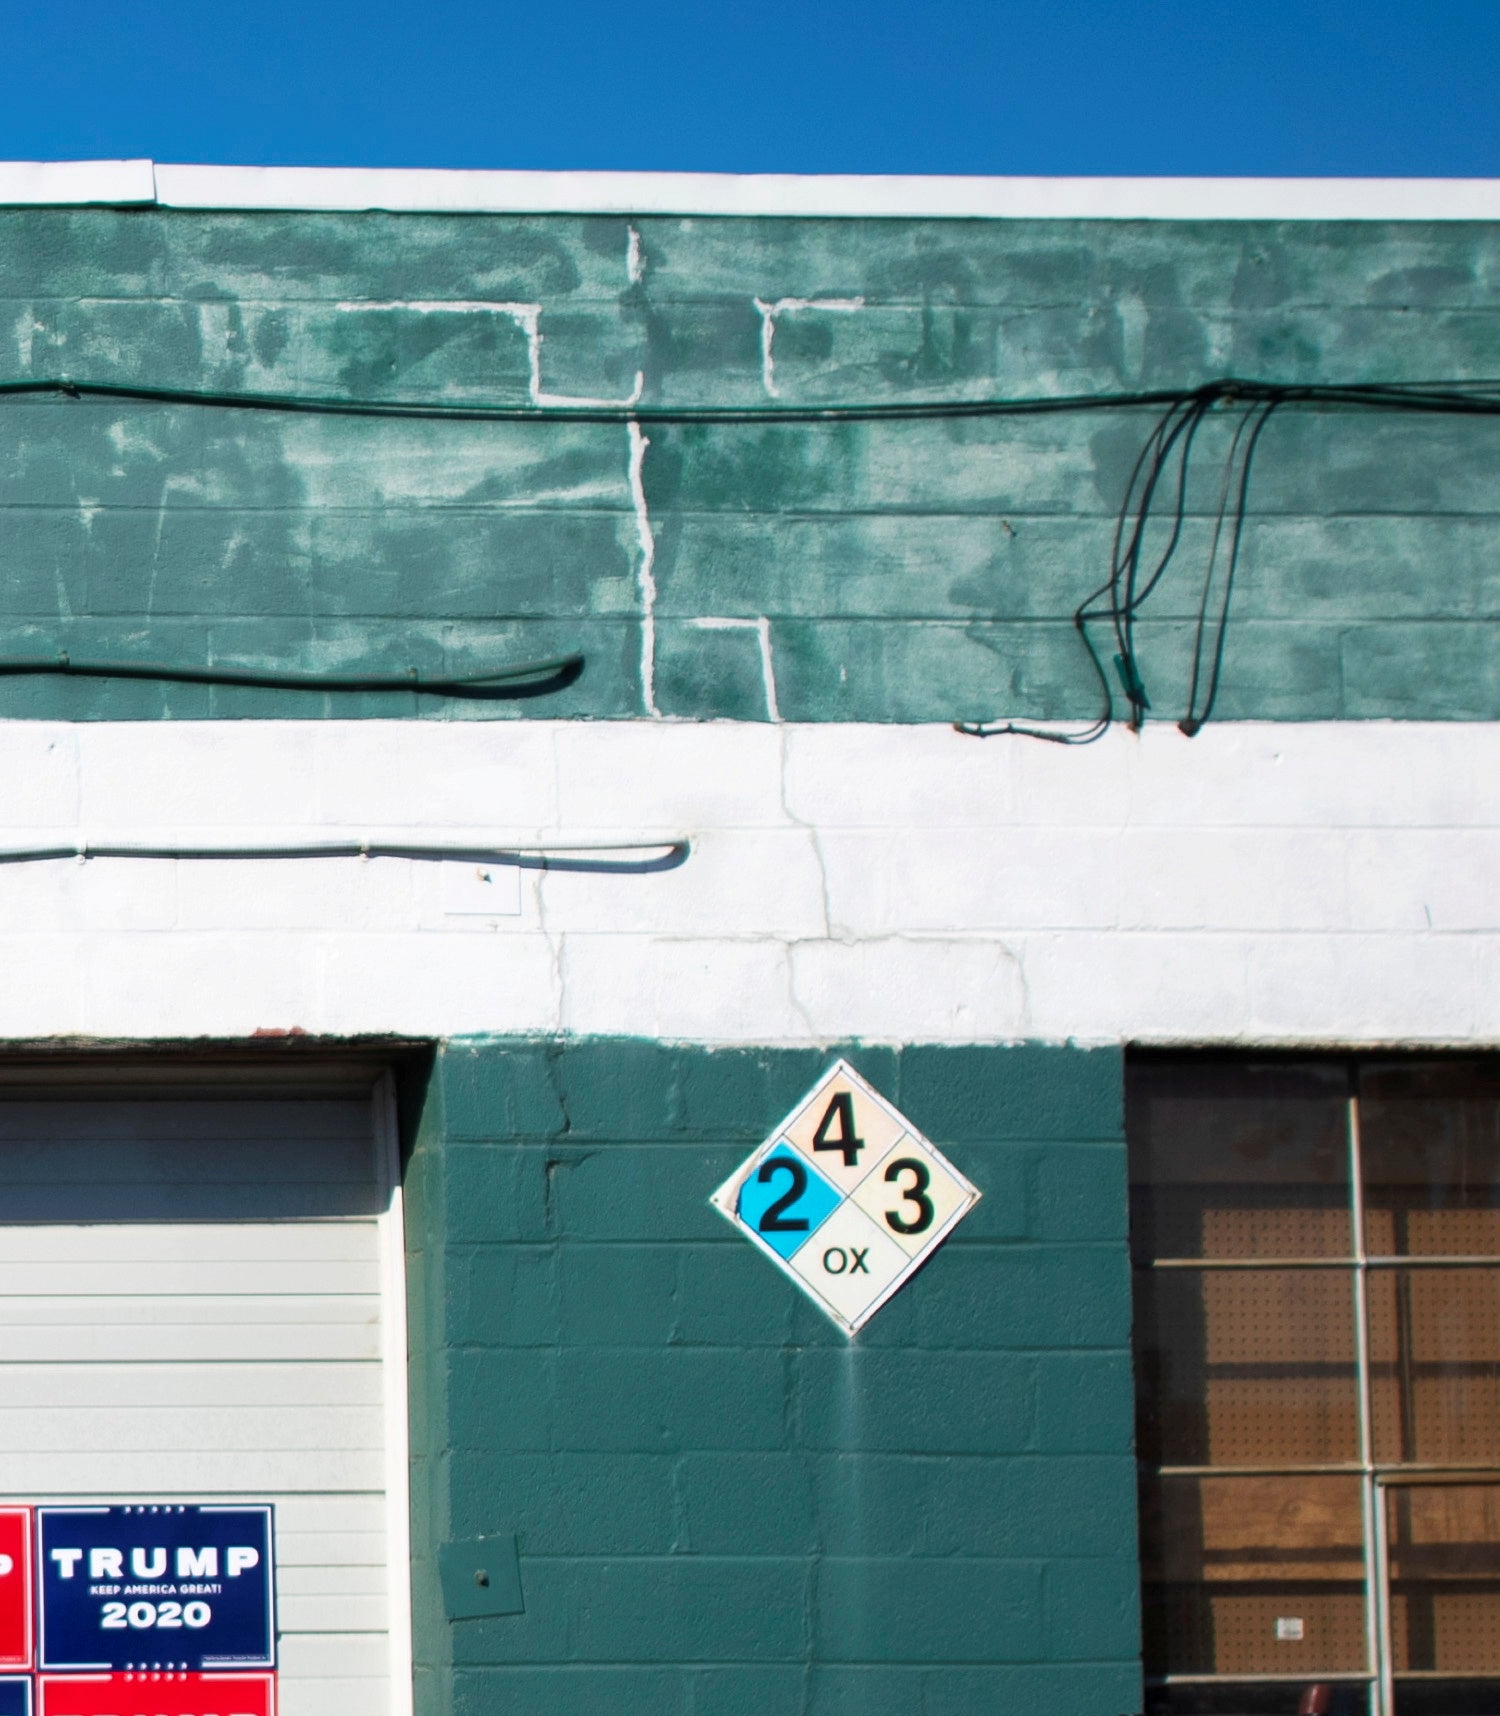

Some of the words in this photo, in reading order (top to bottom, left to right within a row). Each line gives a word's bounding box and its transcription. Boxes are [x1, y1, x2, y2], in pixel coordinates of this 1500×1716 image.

[812, 1091, 865, 1167] 4
[756, 1156, 810, 1232] 2
[884, 1157, 935, 1234] 3
[822, 1247, 870, 1274] OX
[52, 1547, 258, 1578] TRUMP
[91, 1585, 120, 1595] KEEP
[124, 1585, 176, 1594] AMERICA
[180, 1584, 221, 1594] GREAT!
[102, 1602, 211, 1628] 2020
